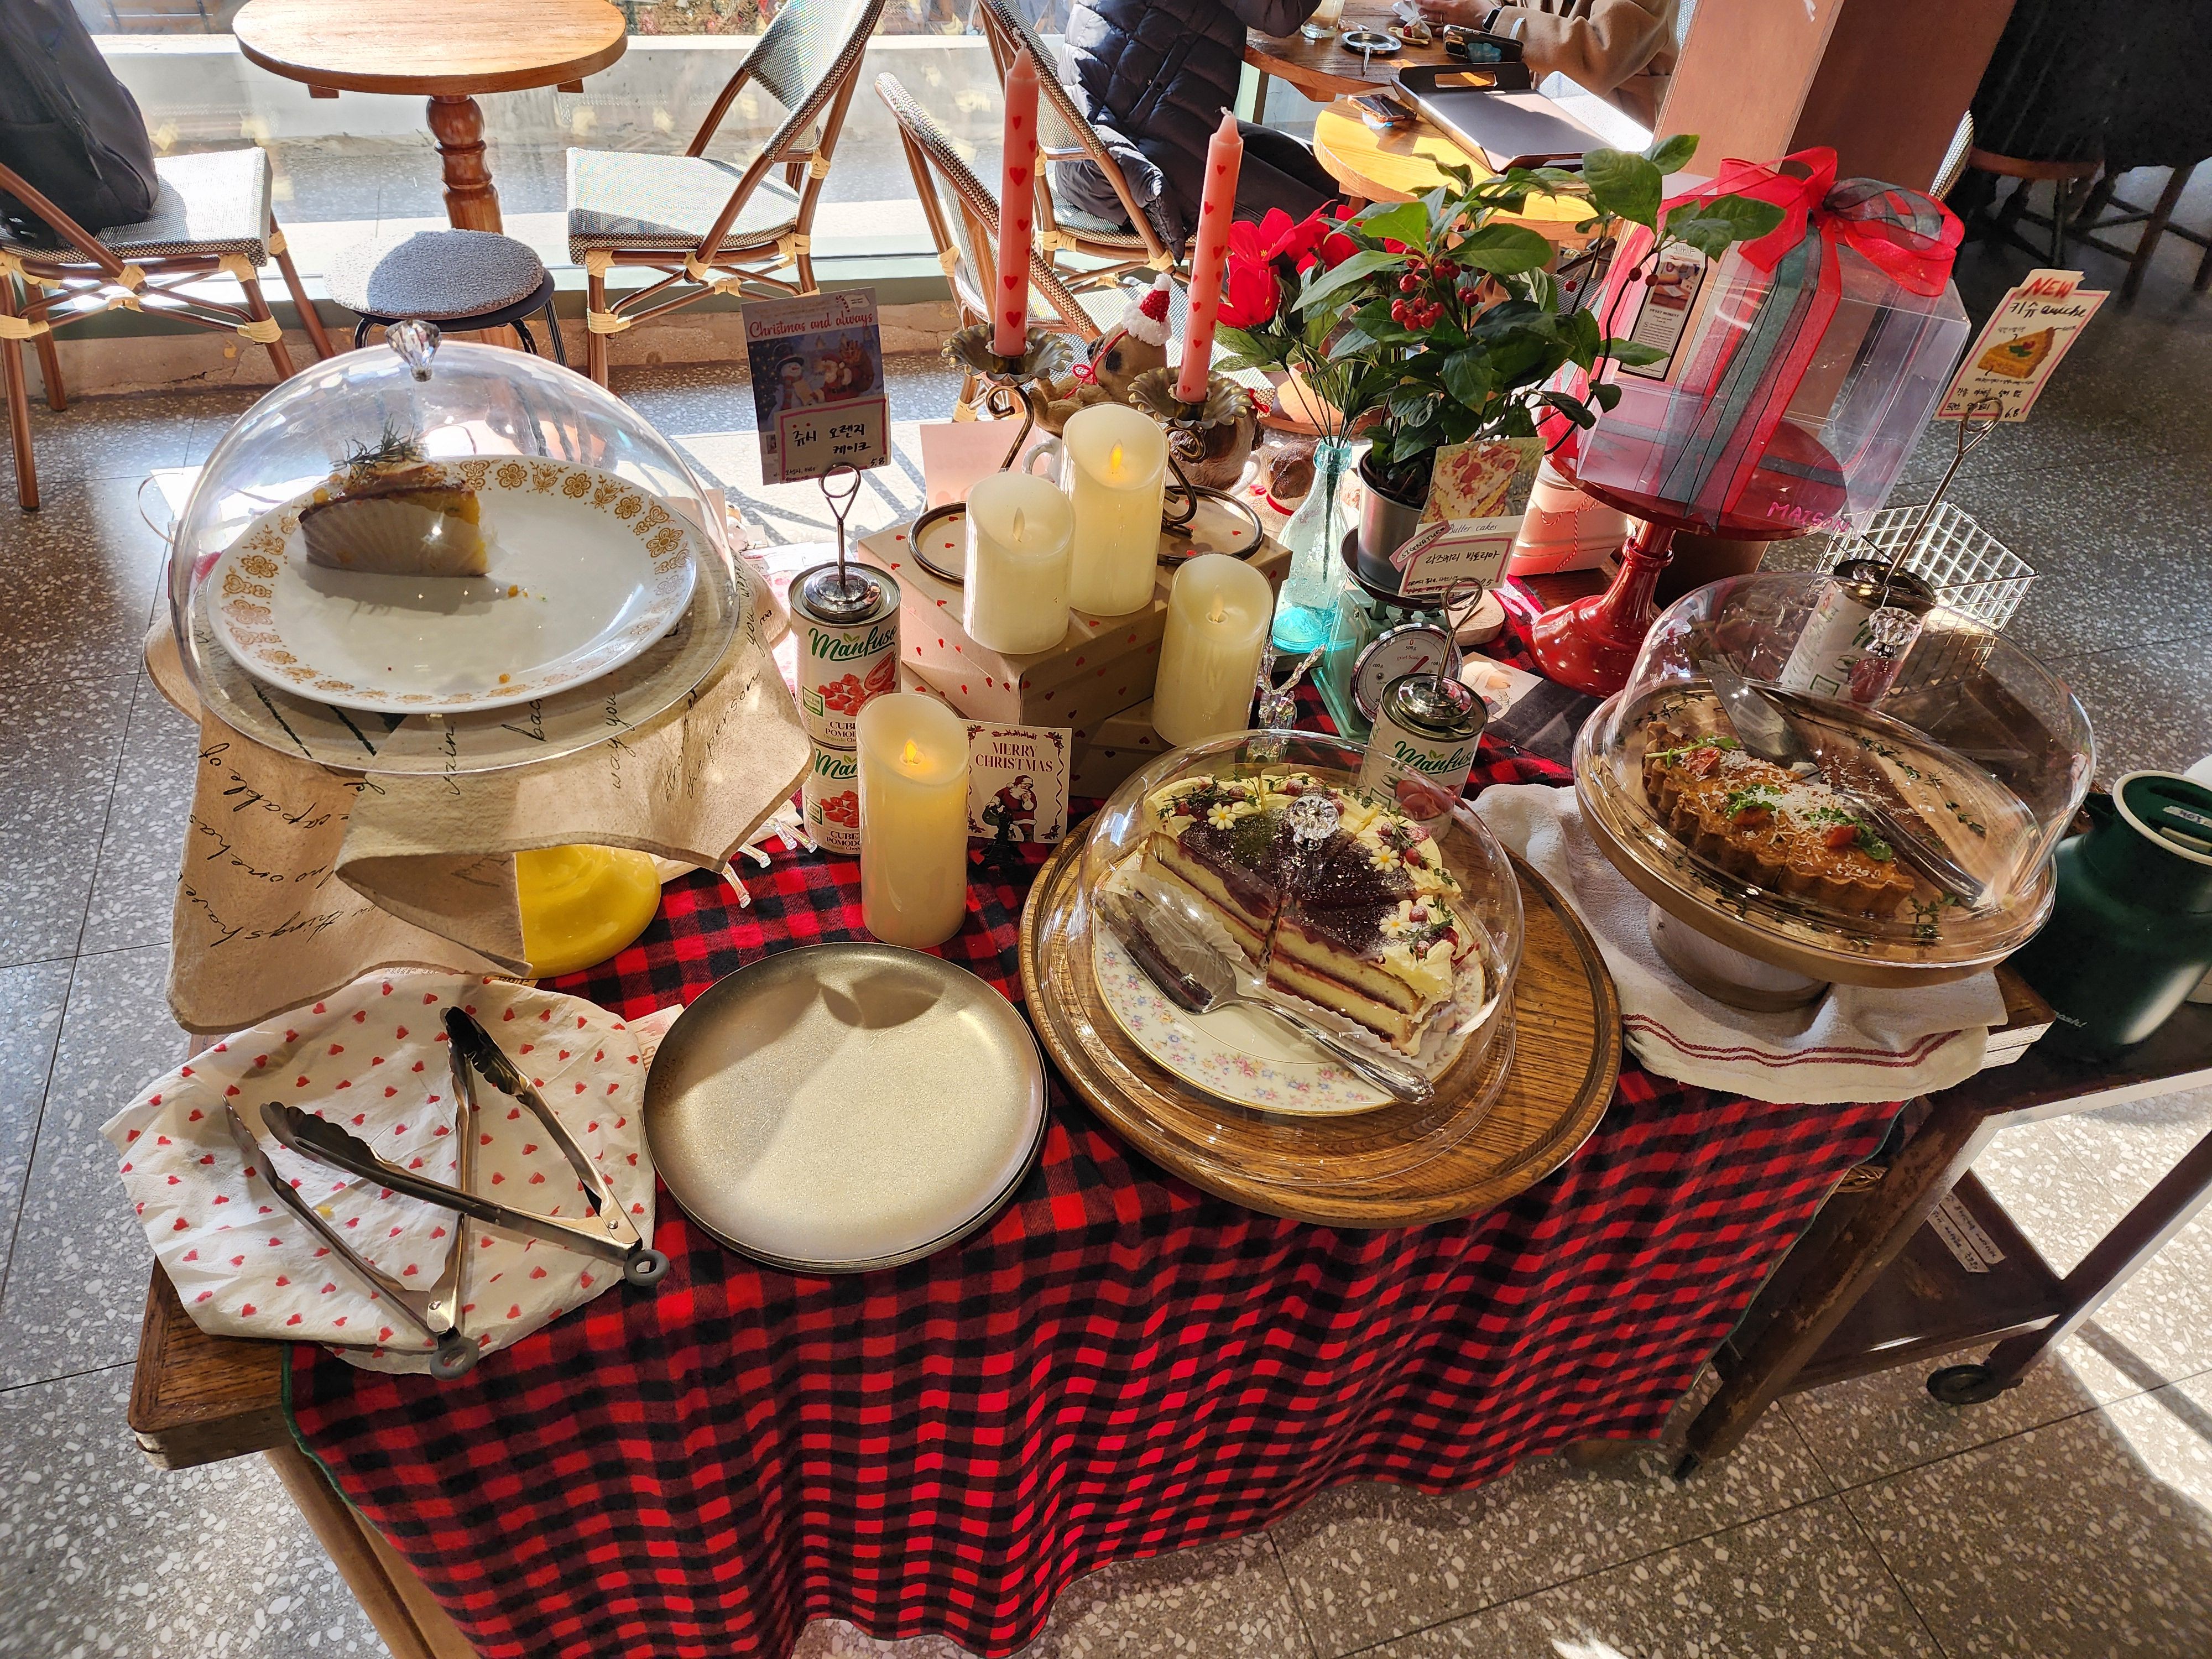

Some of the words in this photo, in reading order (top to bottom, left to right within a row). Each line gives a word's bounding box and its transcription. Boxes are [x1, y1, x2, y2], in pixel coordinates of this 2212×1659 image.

[2021, 277, 2074, 299] NEW
[2009, 301, 2039, 319] 키슈
[749, 320, 806, 338] Christmas
[810, 313, 832, 330] and
[836, 311, 873, 328] always
[2004, 407, 2020, 418] 6.8
[830, 424, 865, 439] 오렌지
[832, 442, 872, 455] 케이크
[870, 457, 885, 467] 5.8
[1475, 522, 1498, 531] cakes
[1767, 502, 1850, 532] MAISON
[1425, 553, 1460, 565] 라즈베리
[1466, 550, 1500, 562] 빅토리아
[808, 625, 897, 662] Manfuso
[707, 669, 761, 765] person
[747, 607, 765, 658] you
[605, 691, 635, 731] you
[198, 743, 230, 766] of
[992, 741, 1037, 757] MERRY
[608, 735, 637, 789] way
[975, 754, 1054, 773] CHRISTMAS
[223, 769, 332, 829] capable
[189, 814, 231, 860] has
[831, 831, 860, 839] CUBE
[231, 853, 284, 883] one
[185, 883, 244, 947] have
[244, 910, 343, 942] things
